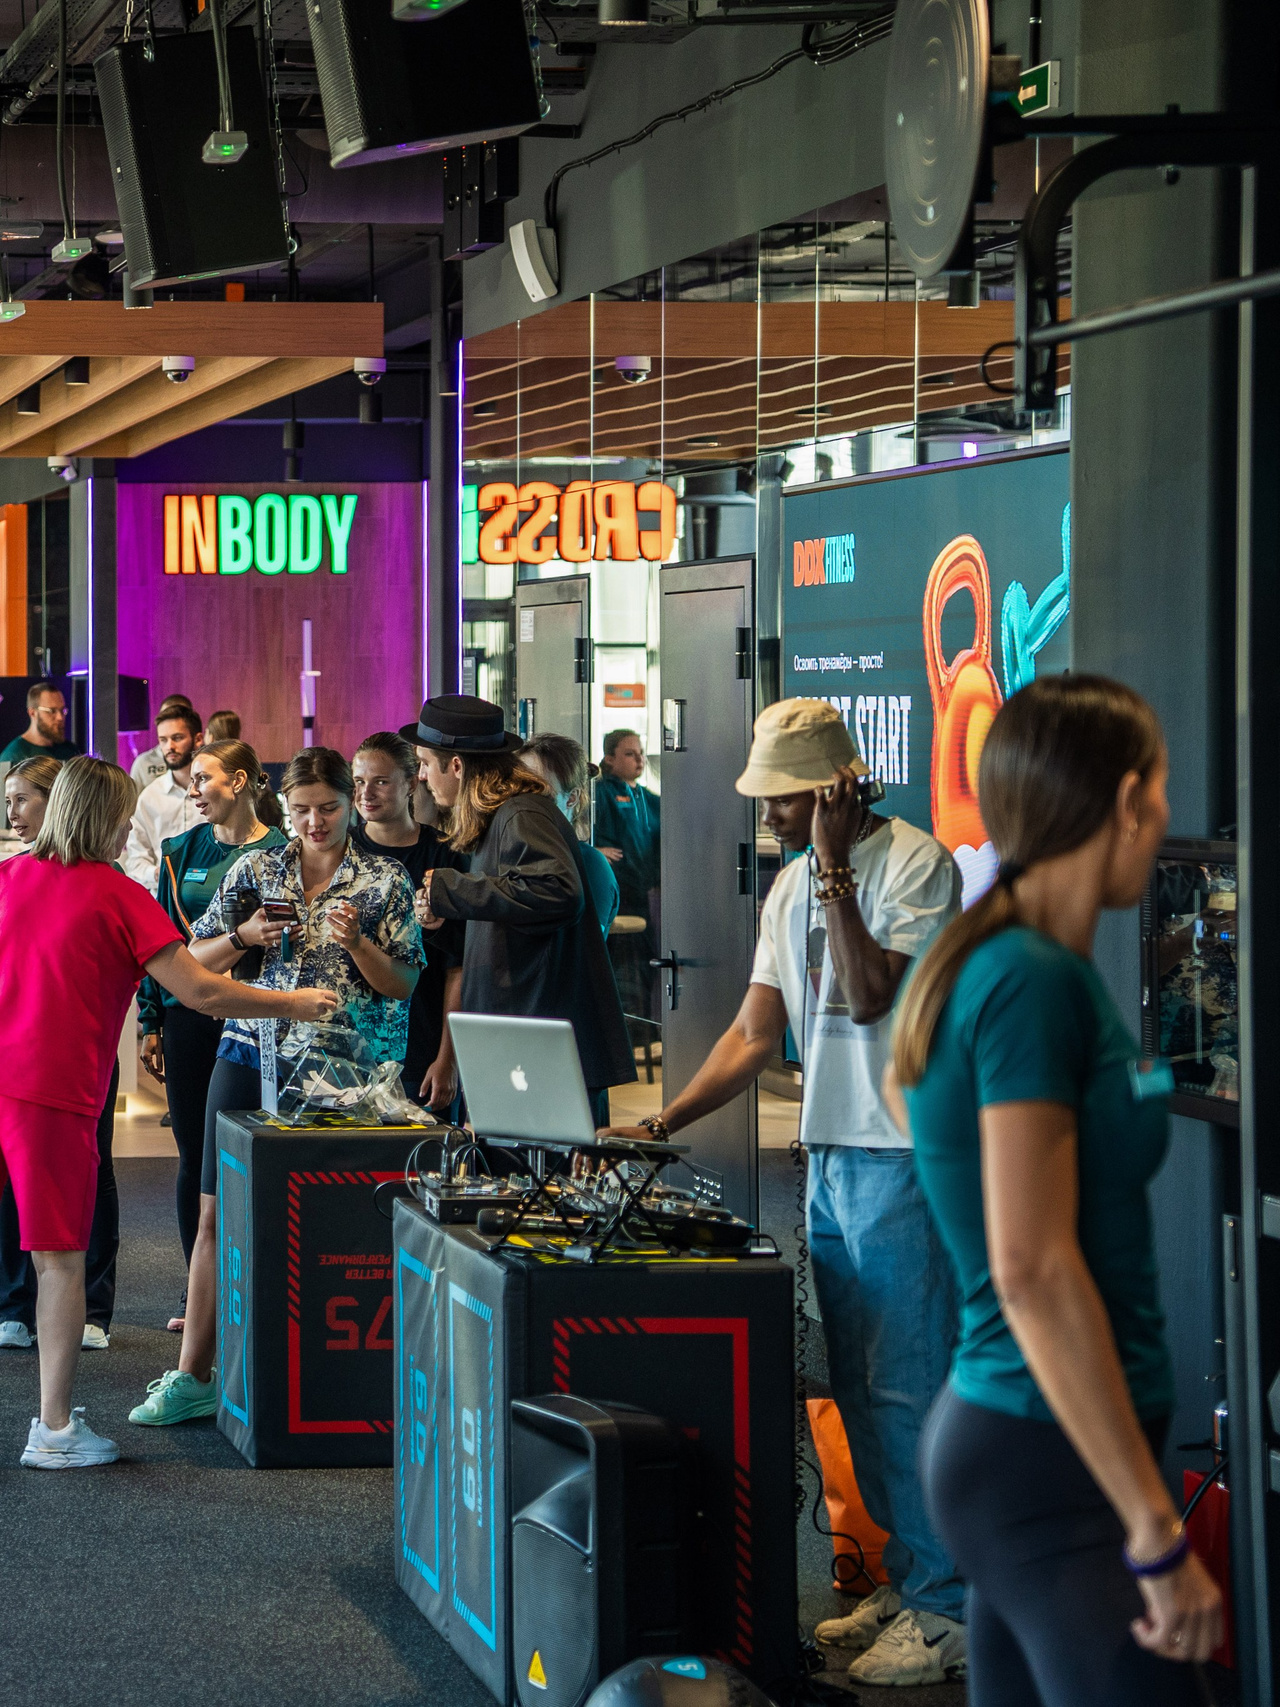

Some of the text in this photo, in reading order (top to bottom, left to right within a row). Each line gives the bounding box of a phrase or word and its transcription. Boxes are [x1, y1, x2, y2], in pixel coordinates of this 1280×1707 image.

[163, 493, 359, 576] INBODY
[859, 651, 884, 673] просто!
[855, 694, 912, 785] START
[628, 1216, 676, 1231] Pioeer
[345, 1268, 385, 1280] BETTER
[325, 1295, 394, 1351] 75
